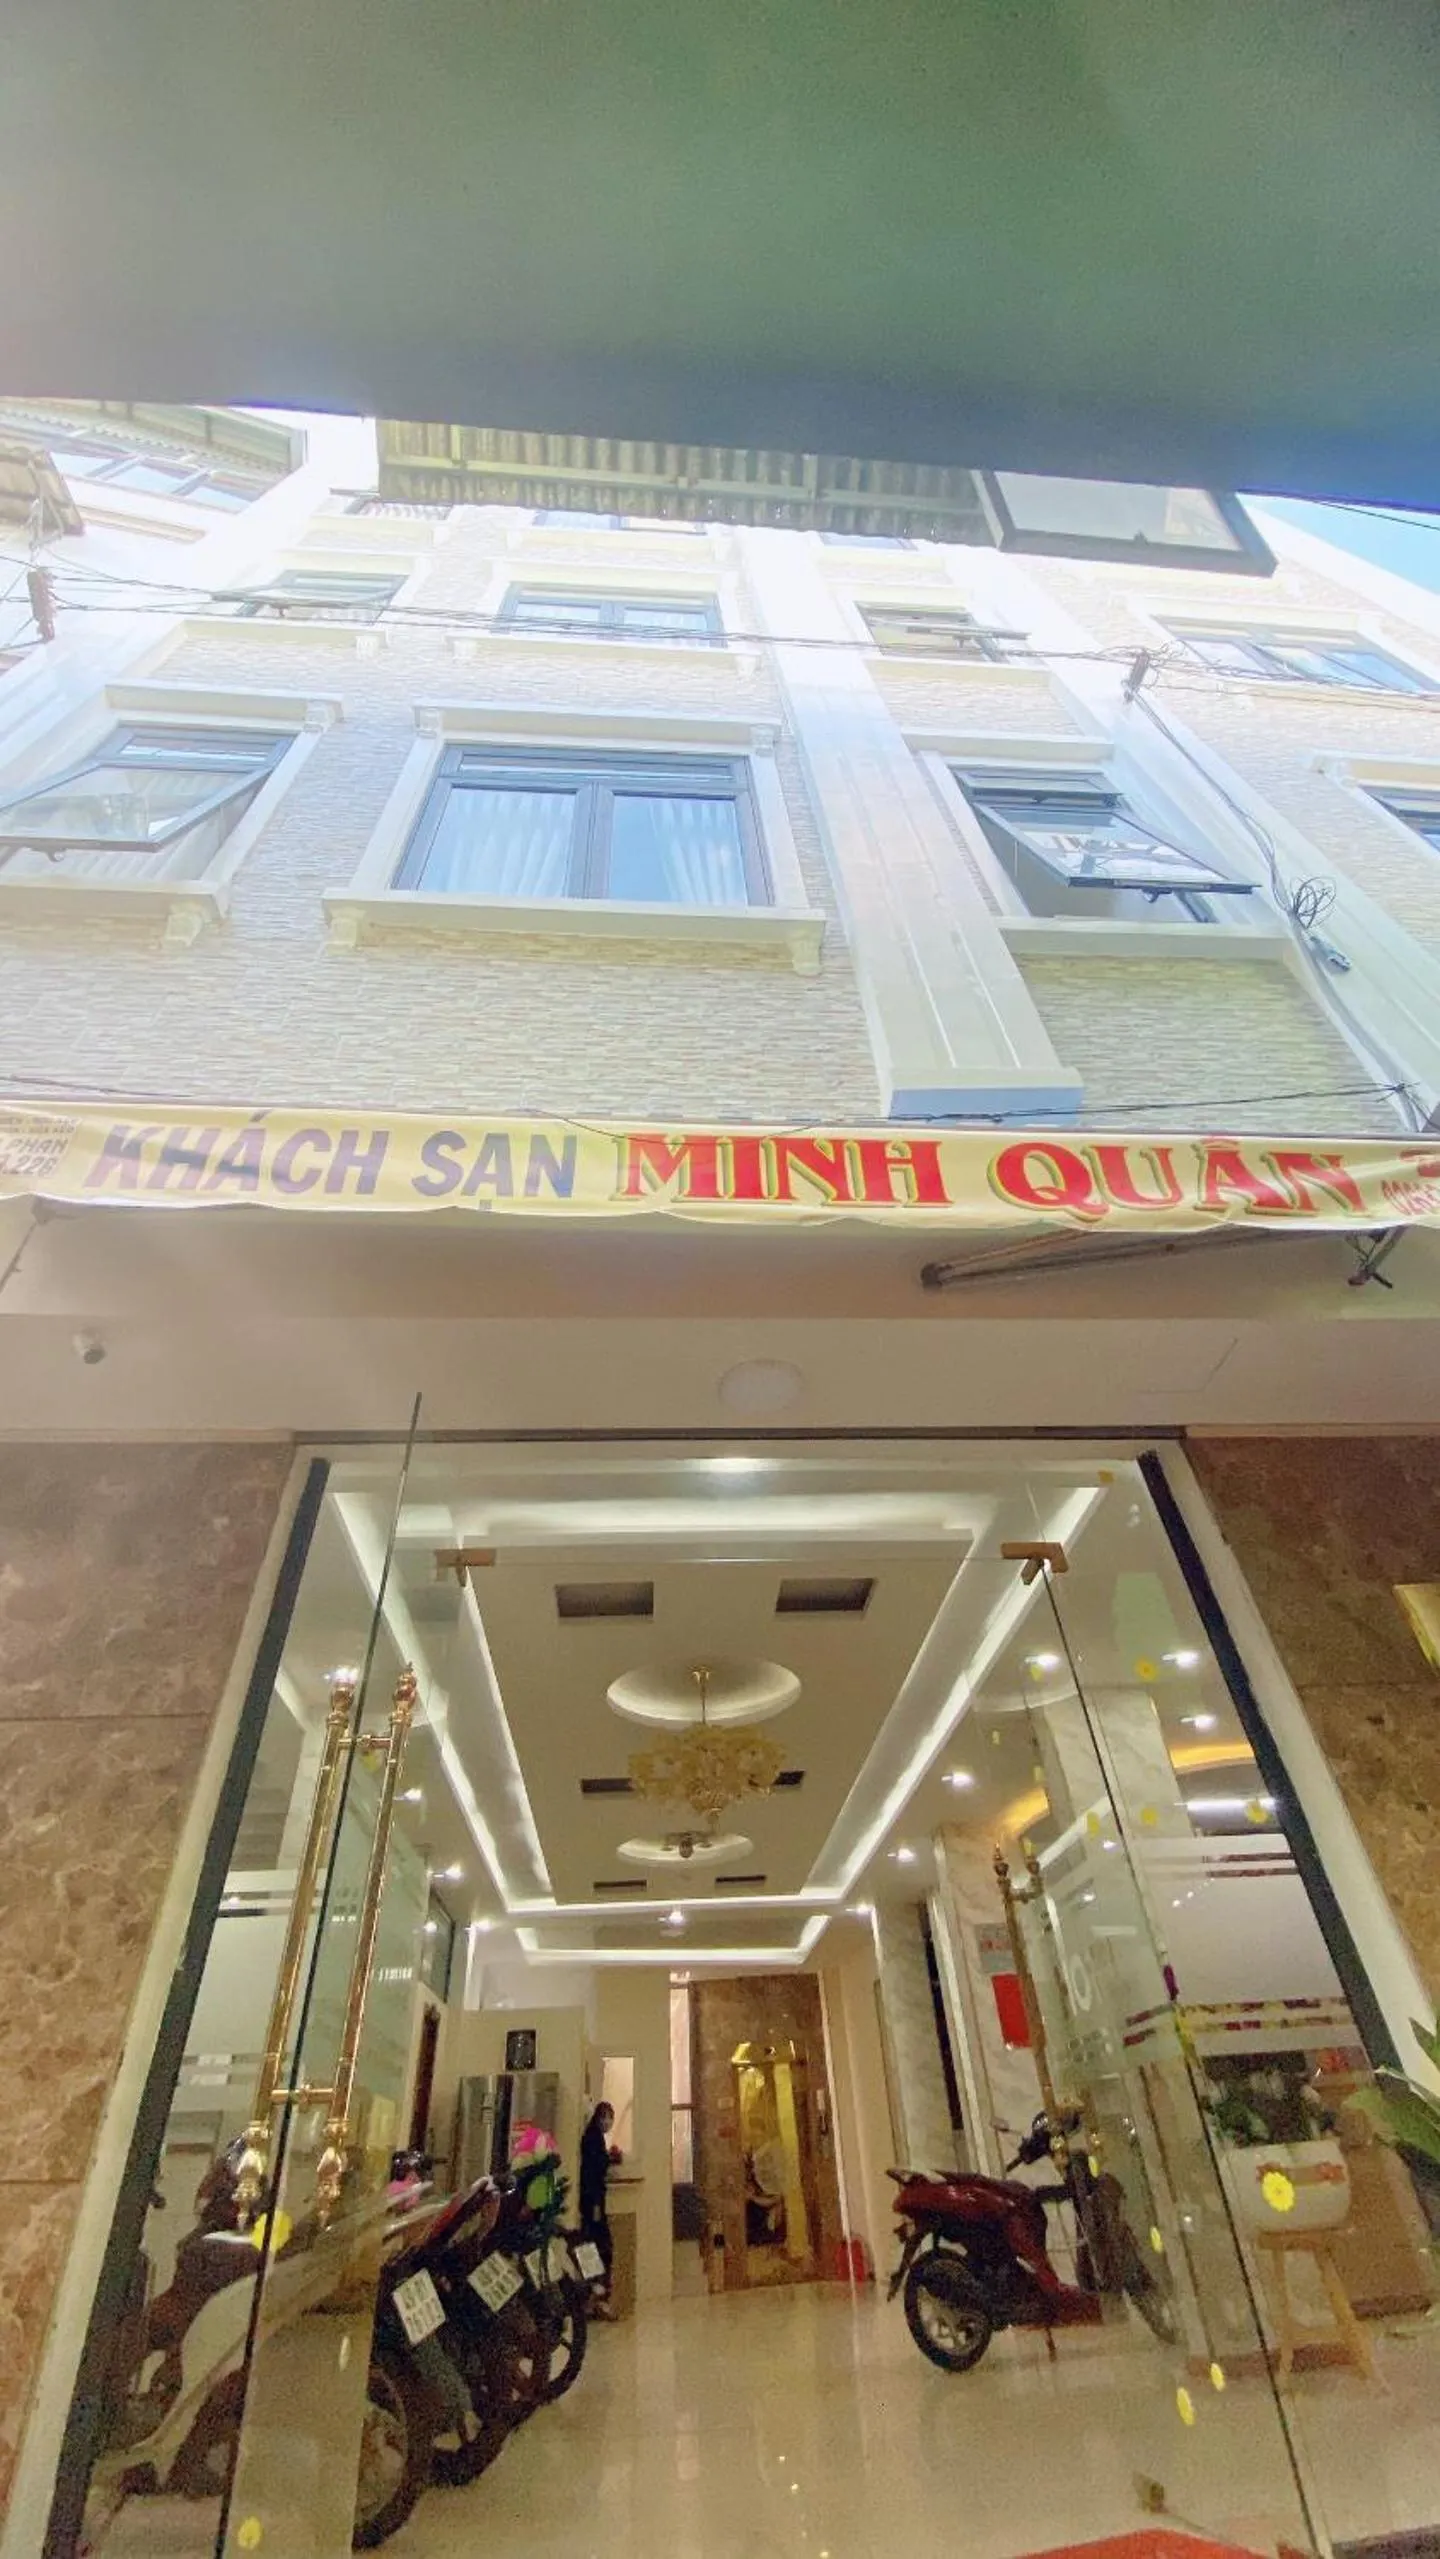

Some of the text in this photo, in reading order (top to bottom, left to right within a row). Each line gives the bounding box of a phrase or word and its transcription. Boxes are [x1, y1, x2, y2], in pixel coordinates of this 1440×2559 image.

[84, 1109, 389, 1194] KHÁCH
[411, 1130, 578, 1209] SẠN
[612, 1134, 953, 1207] MINH
[987, 1136, 1371, 1222] QUÂN
